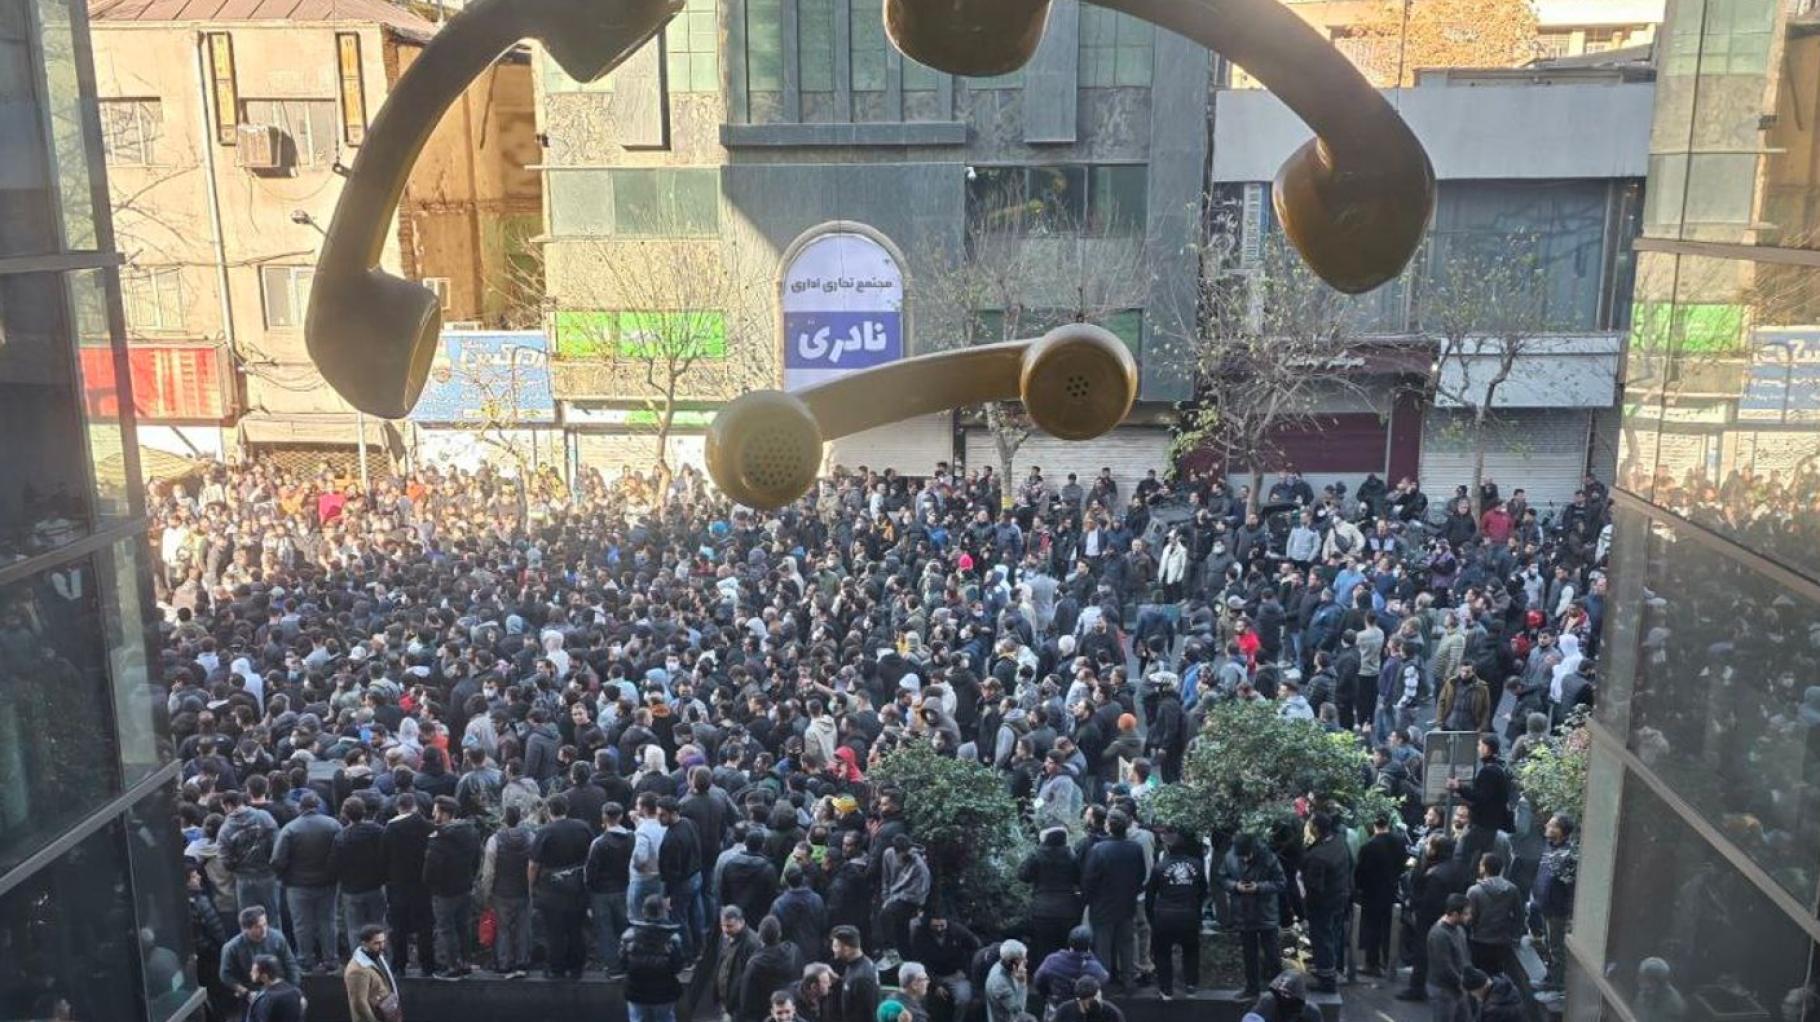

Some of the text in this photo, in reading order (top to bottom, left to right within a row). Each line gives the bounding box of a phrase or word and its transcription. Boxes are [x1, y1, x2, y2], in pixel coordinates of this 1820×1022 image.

[791, 277, 893, 293] مجتمع تجاری اداری
[799, 320, 887, 363] نادری
